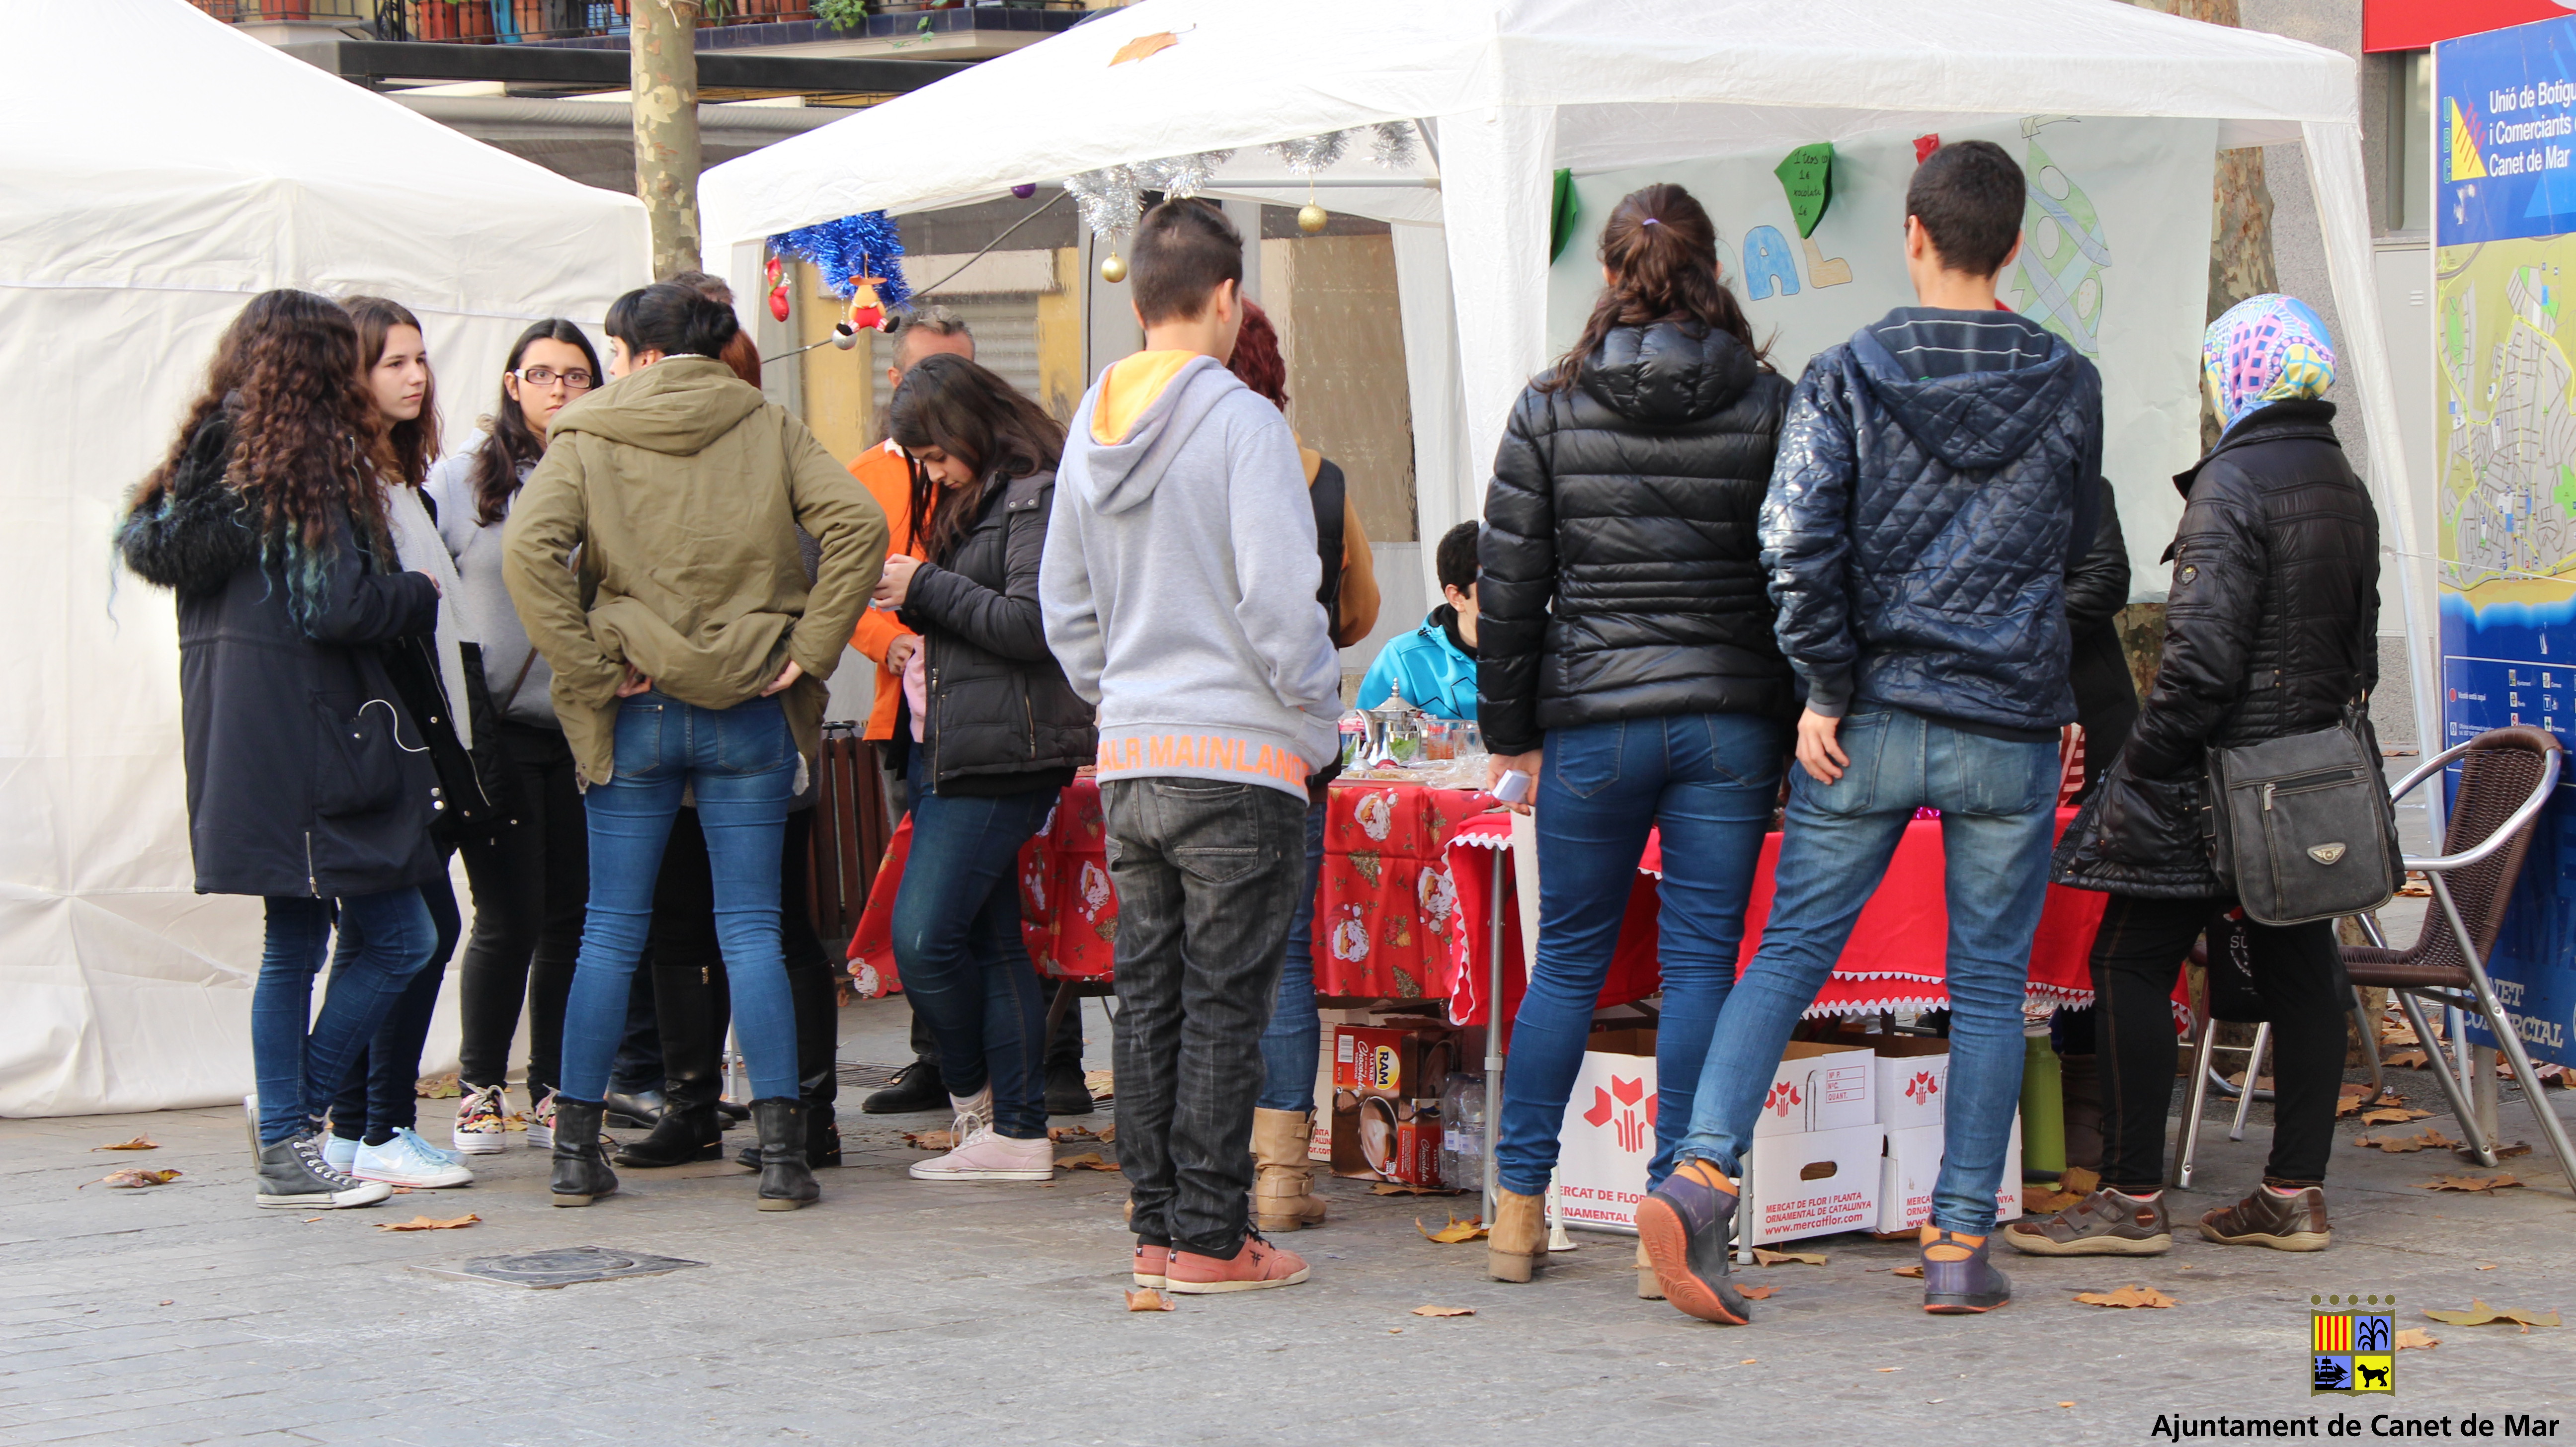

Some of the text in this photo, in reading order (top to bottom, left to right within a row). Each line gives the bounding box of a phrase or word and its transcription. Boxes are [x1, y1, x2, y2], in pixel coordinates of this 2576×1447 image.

[2489, 86, 2516, 114] Unió
[2519, 84, 2535, 109] de
[2489, 122, 2493, 146] i
[2496, 113, 2572, 145] Comerciants
[2489, 145, 2571, 177] Canet de Mar
[1358, 1041, 1368, 1091] Chocolate
[1379, 1051, 1389, 1084] RAM
[1421, 1139, 1430, 1182] Chocolate
[1598, 1190, 1614, 1202] DE
[1766, 1202, 1795, 1213] MERCAT
[1797, 1200, 1806, 1209] DE
[1808, 1197, 1826, 1207] FLOR
[1834, 1192, 1861, 1203] PLANTA
[1907, 1196, 1932, 1206] MERCA
[1765, 1213, 1863, 1236] www.mercatflor.com
[1766, 1210, 1816, 1224] ORNAMENTAL
[1829, 1201, 1872, 1214] CATALUNYA
